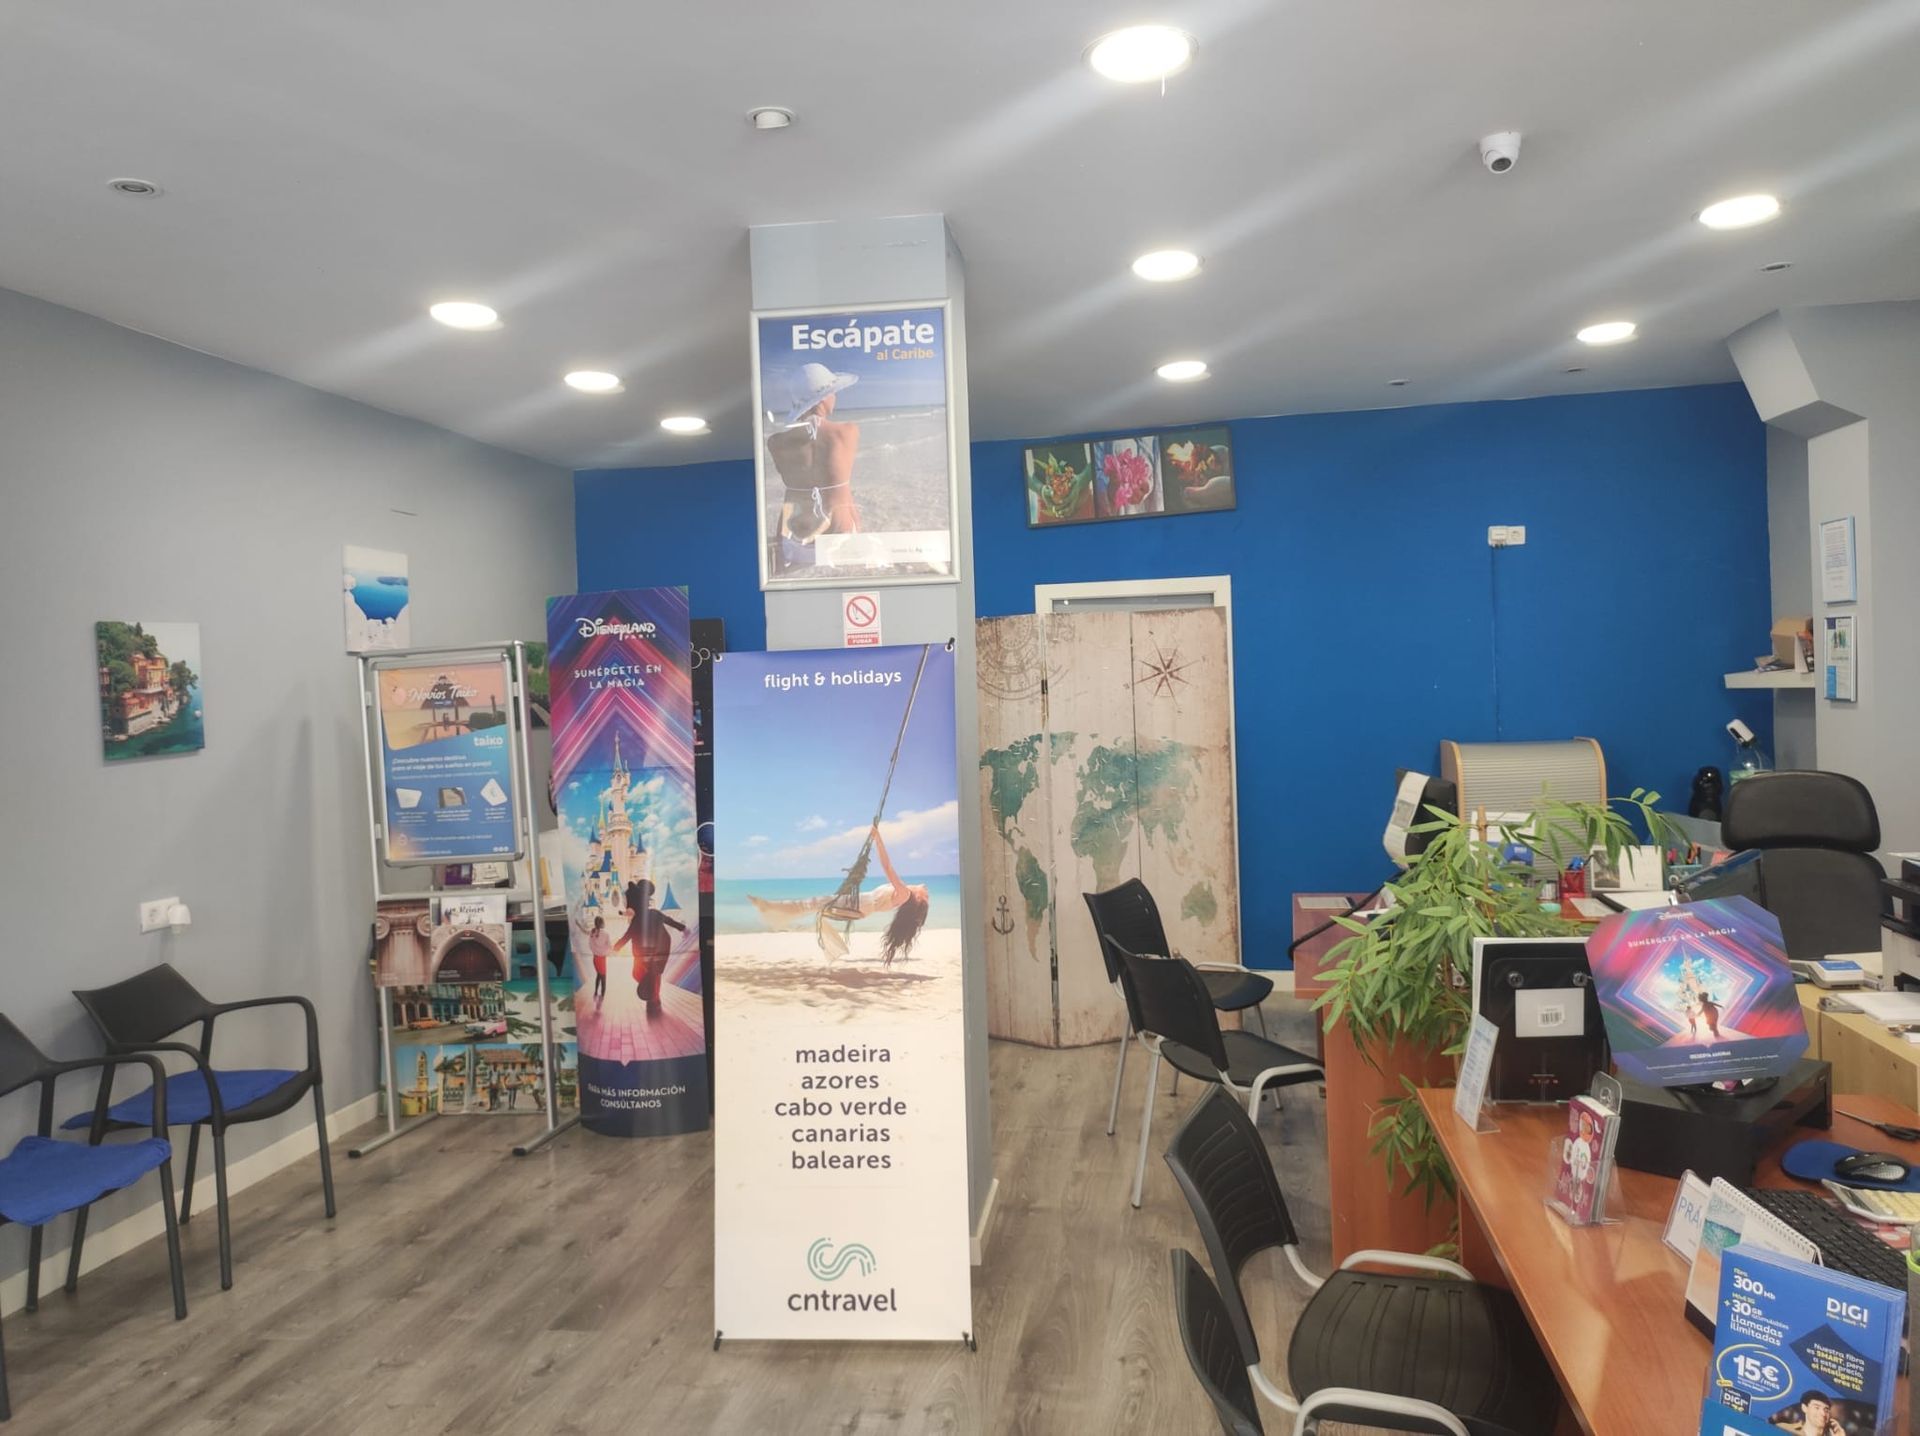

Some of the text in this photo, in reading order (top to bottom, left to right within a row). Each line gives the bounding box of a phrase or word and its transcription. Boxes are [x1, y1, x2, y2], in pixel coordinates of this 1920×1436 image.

[792, 319, 935, 353] Escápate
[876, 349, 935, 361] al Caribe
[574, 664, 662, 679] SUMÉRGETE EN
[765, 670, 902, 690] flight & holidays
[590, 678, 645, 690] LA MAGIA
[474, 735, 503, 746] taiko
[1708, 927, 1737, 936] MAGIA
[796, 1044, 891, 1063] madeira
[801, 1074, 880, 1089] azores
[601, 1087, 616, 1097] MÁS
[618, 1085, 686, 1098] INFORMACIÓN
[600, 1098, 662, 1109] CONSÚLTANOS
[775, 1096, 907, 1116] cabo verde
[791, 1123, 891, 1142] canarias
[792, 1150, 892, 1169] baleares
[1733, 1274, 1764, 1295] 300
[787, 1287, 897, 1312] cntravel
[1826, 1296, 1869, 1323] DIGI
[1730, 1312, 1783, 1338] Llamadas
[1806, 1347, 1816, 1355] es
[1846, 1360, 1865, 1373] pero
[1814, 1342, 1865, 1366] Nuestra fibra
[1733, 1354, 1779, 1382] 15€
